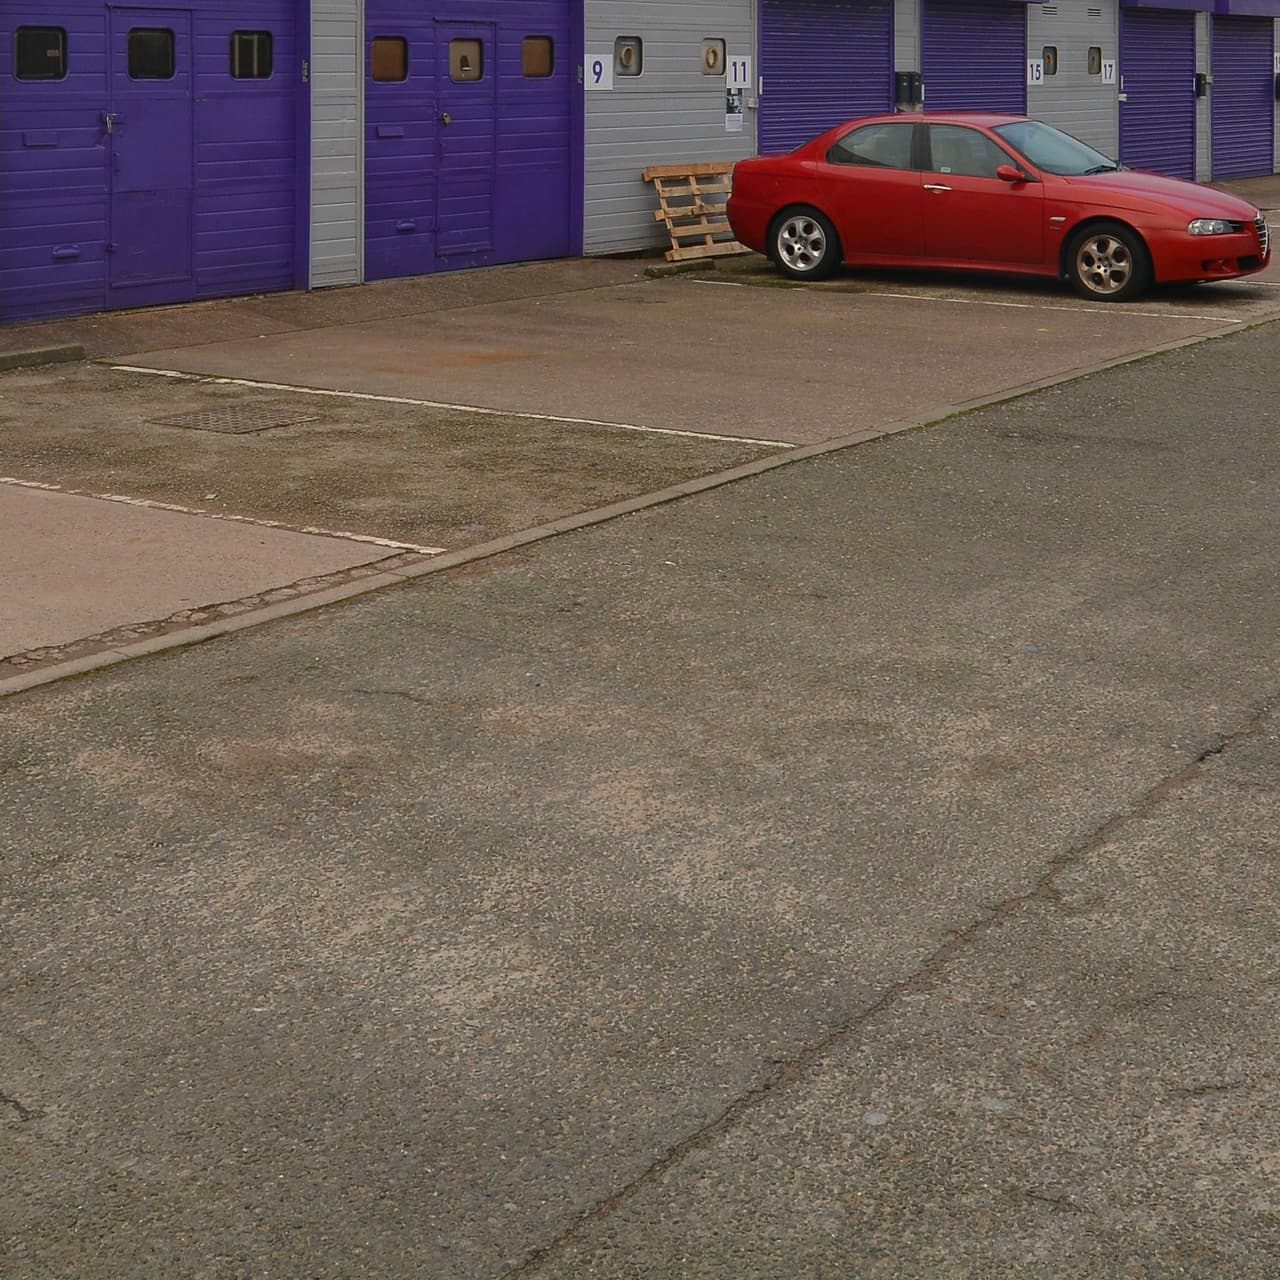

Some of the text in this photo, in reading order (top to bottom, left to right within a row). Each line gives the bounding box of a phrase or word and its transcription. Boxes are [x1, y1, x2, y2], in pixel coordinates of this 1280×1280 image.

[592, 60, 603, 84] 9
[732, 61, 746, 83] 11
[1029, 63, 1041, 81] 15
[1103, 63, 1113, 80] 17
